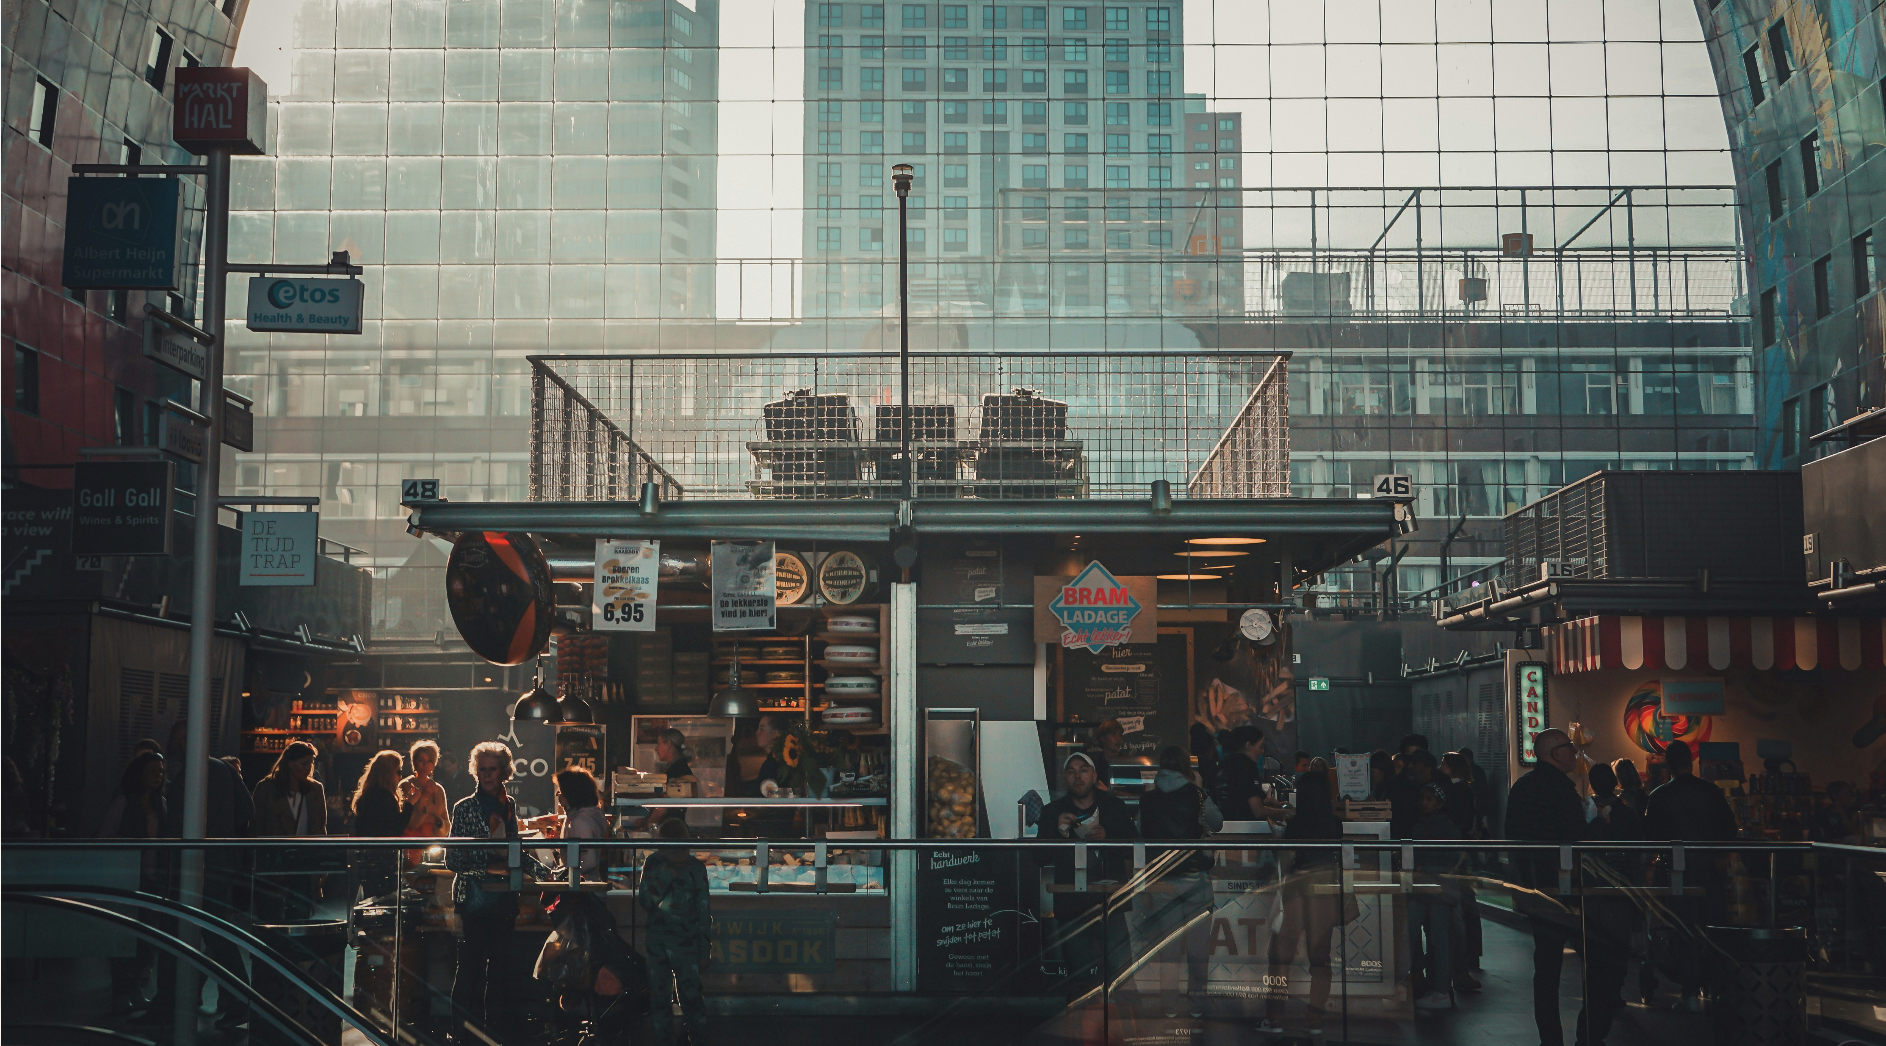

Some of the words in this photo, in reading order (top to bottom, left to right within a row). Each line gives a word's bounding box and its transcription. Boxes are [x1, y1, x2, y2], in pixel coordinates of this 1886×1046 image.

[178, 82, 242, 100] MARKT
[184, 102, 232, 129] HAL
[73, 246, 122, 261] Albert
[127, 246, 167, 263] Heijn
[73, 265, 165, 282] Supermarkt
[275, 283, 341, 307] etos
[254, 312, 293, 324] Health
[297, 313, 306, 323] &
[309, 312, 351, 327] Beauty
[405, 481, 438, 500] 48
[1376, 476, 1410, 495] 46
[81, 487, 116, 507] Gall
[126, 487, 162, 507] Gall
[0, 508, 36, 521] race
[80, 516, 113, 525] Wines
[116, 516, 125, 525] &
[127, 515, 161, 528] Spirits
[14, 523, 54, 536] view
[253, 520, 277, 536] DE
[251, 537, 295, 553] TIJD
[250, 554, 302, 570] TRAP
[612, 565, 640, 574] Boeren
[1550, 563, 1573, 577] 16
[602, 575, 650, 585] Brokkelkaas
[1064, 587, 1129, 606] BRAM
[603, 602, 644, 624] 6,95
[720, 609, 737, 618] vind
[749, 608, 768, 617] hier!
[1063, 610, 1129, 624] LADAGE
[1063, 627, 1090, 646] Echt
[1090, 626, 1131, 643] lekker!
[1112, 646, 1133, 659] hier
[1104, 685, 1133, 706] patat
[1526, 671, 1540, 743] CANDY
[930, 850, 981, 870] handwerk
[959, 878, 971, 887] dag
[1781, 898, 1807, 907] WRAPS
[711, 921, 784, 936] MWIJK
[941, 925, 955, 934] om
[967, 921, 982, 929] hier
[982, 917, 993, 929] te
[936, 933, 962, 948] snijden
[963, 931, 977, 944] tot
[977, 926, 1001, 942] patat
[710, 939, 823, 964] ASDOK
